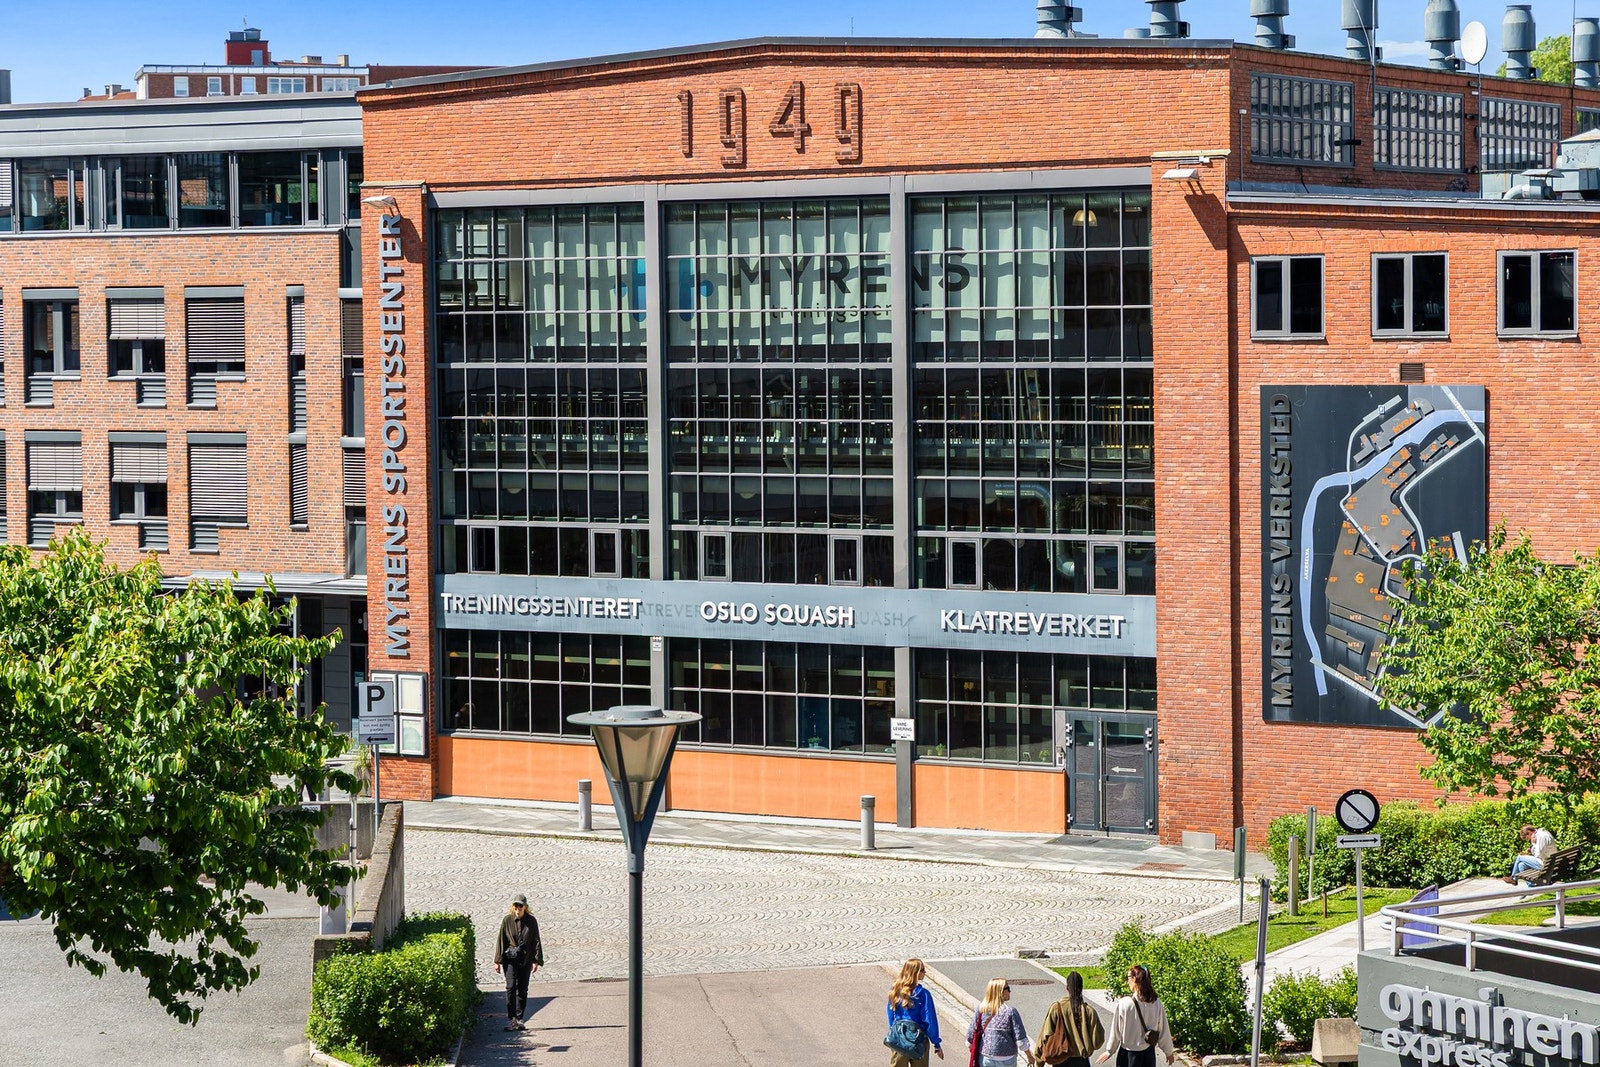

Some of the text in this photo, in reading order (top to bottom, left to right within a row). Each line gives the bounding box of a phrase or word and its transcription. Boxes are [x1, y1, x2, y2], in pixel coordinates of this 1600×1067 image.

[677, 80, 863, 168] 1949
[733, 247, 971, 296] MYRENS
[379, 213, 409, 657] MYRENS SPORTSSENTER
[1270, 393, 1293, 705] MYRENS VERKSTED
[1355, 572, 1364, 584] 6
[440, 592, 642, 618] TRENINGSSENTERET
[700, 600, 855, 628] OSLO SQUASH
[940, 609, 1126, 637] KLATREVERKET
[367, 685, 385, 712] P
[1379, 984, 1600, 1065] onninen
[1381, 1027, 1512, 1067] express
